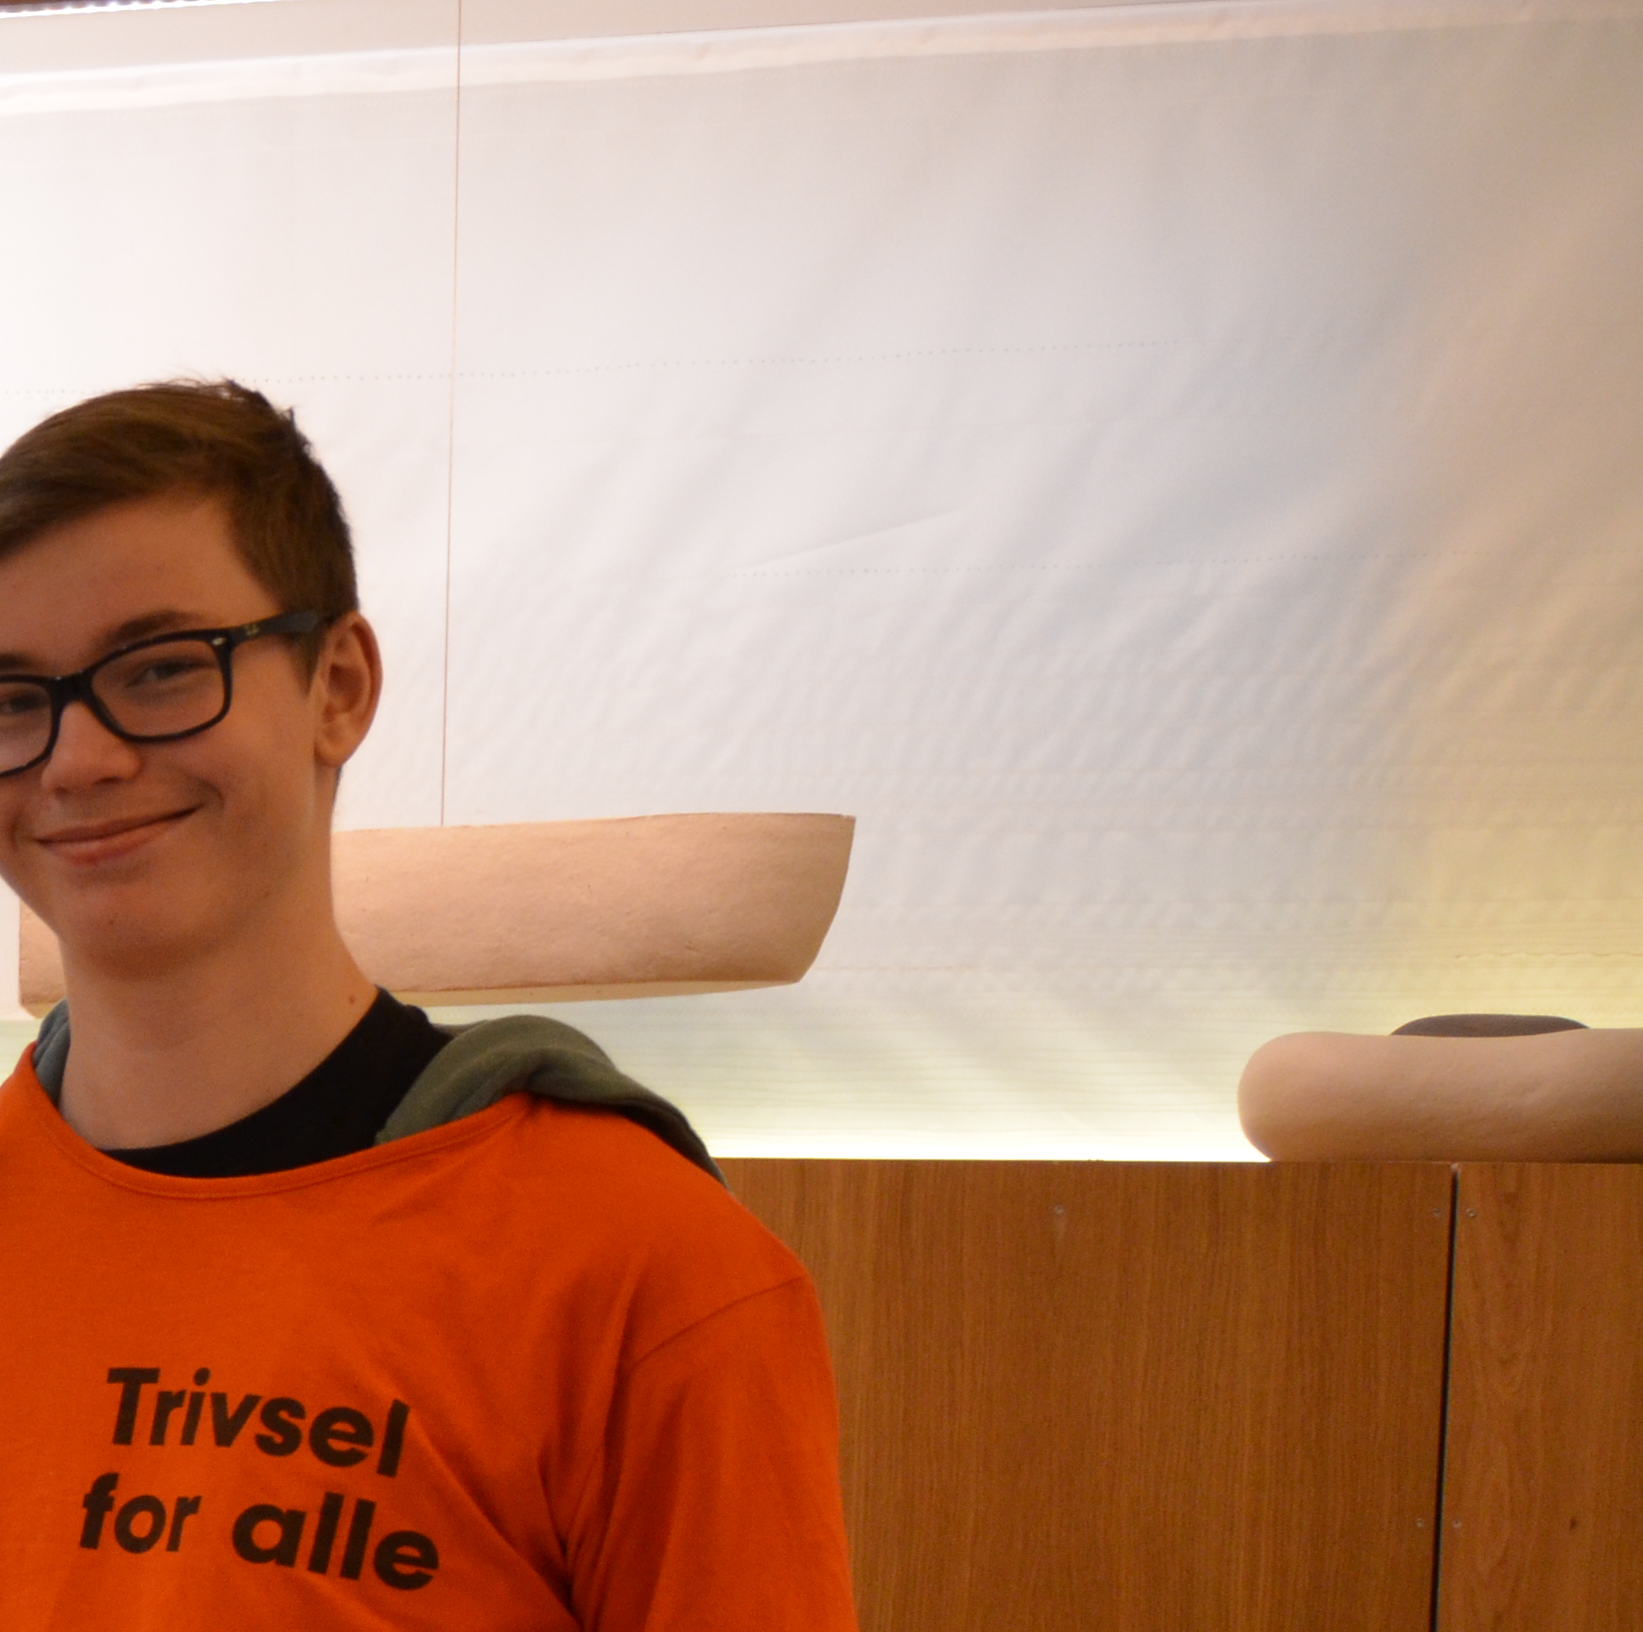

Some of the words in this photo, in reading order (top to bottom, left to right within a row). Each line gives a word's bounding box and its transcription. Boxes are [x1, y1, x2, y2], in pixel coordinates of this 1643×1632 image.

[106, 1366, 410, 1478] Trivsel
[79, 1472, 202, 1555] for
[231, 1491, 440, 1591] alle
